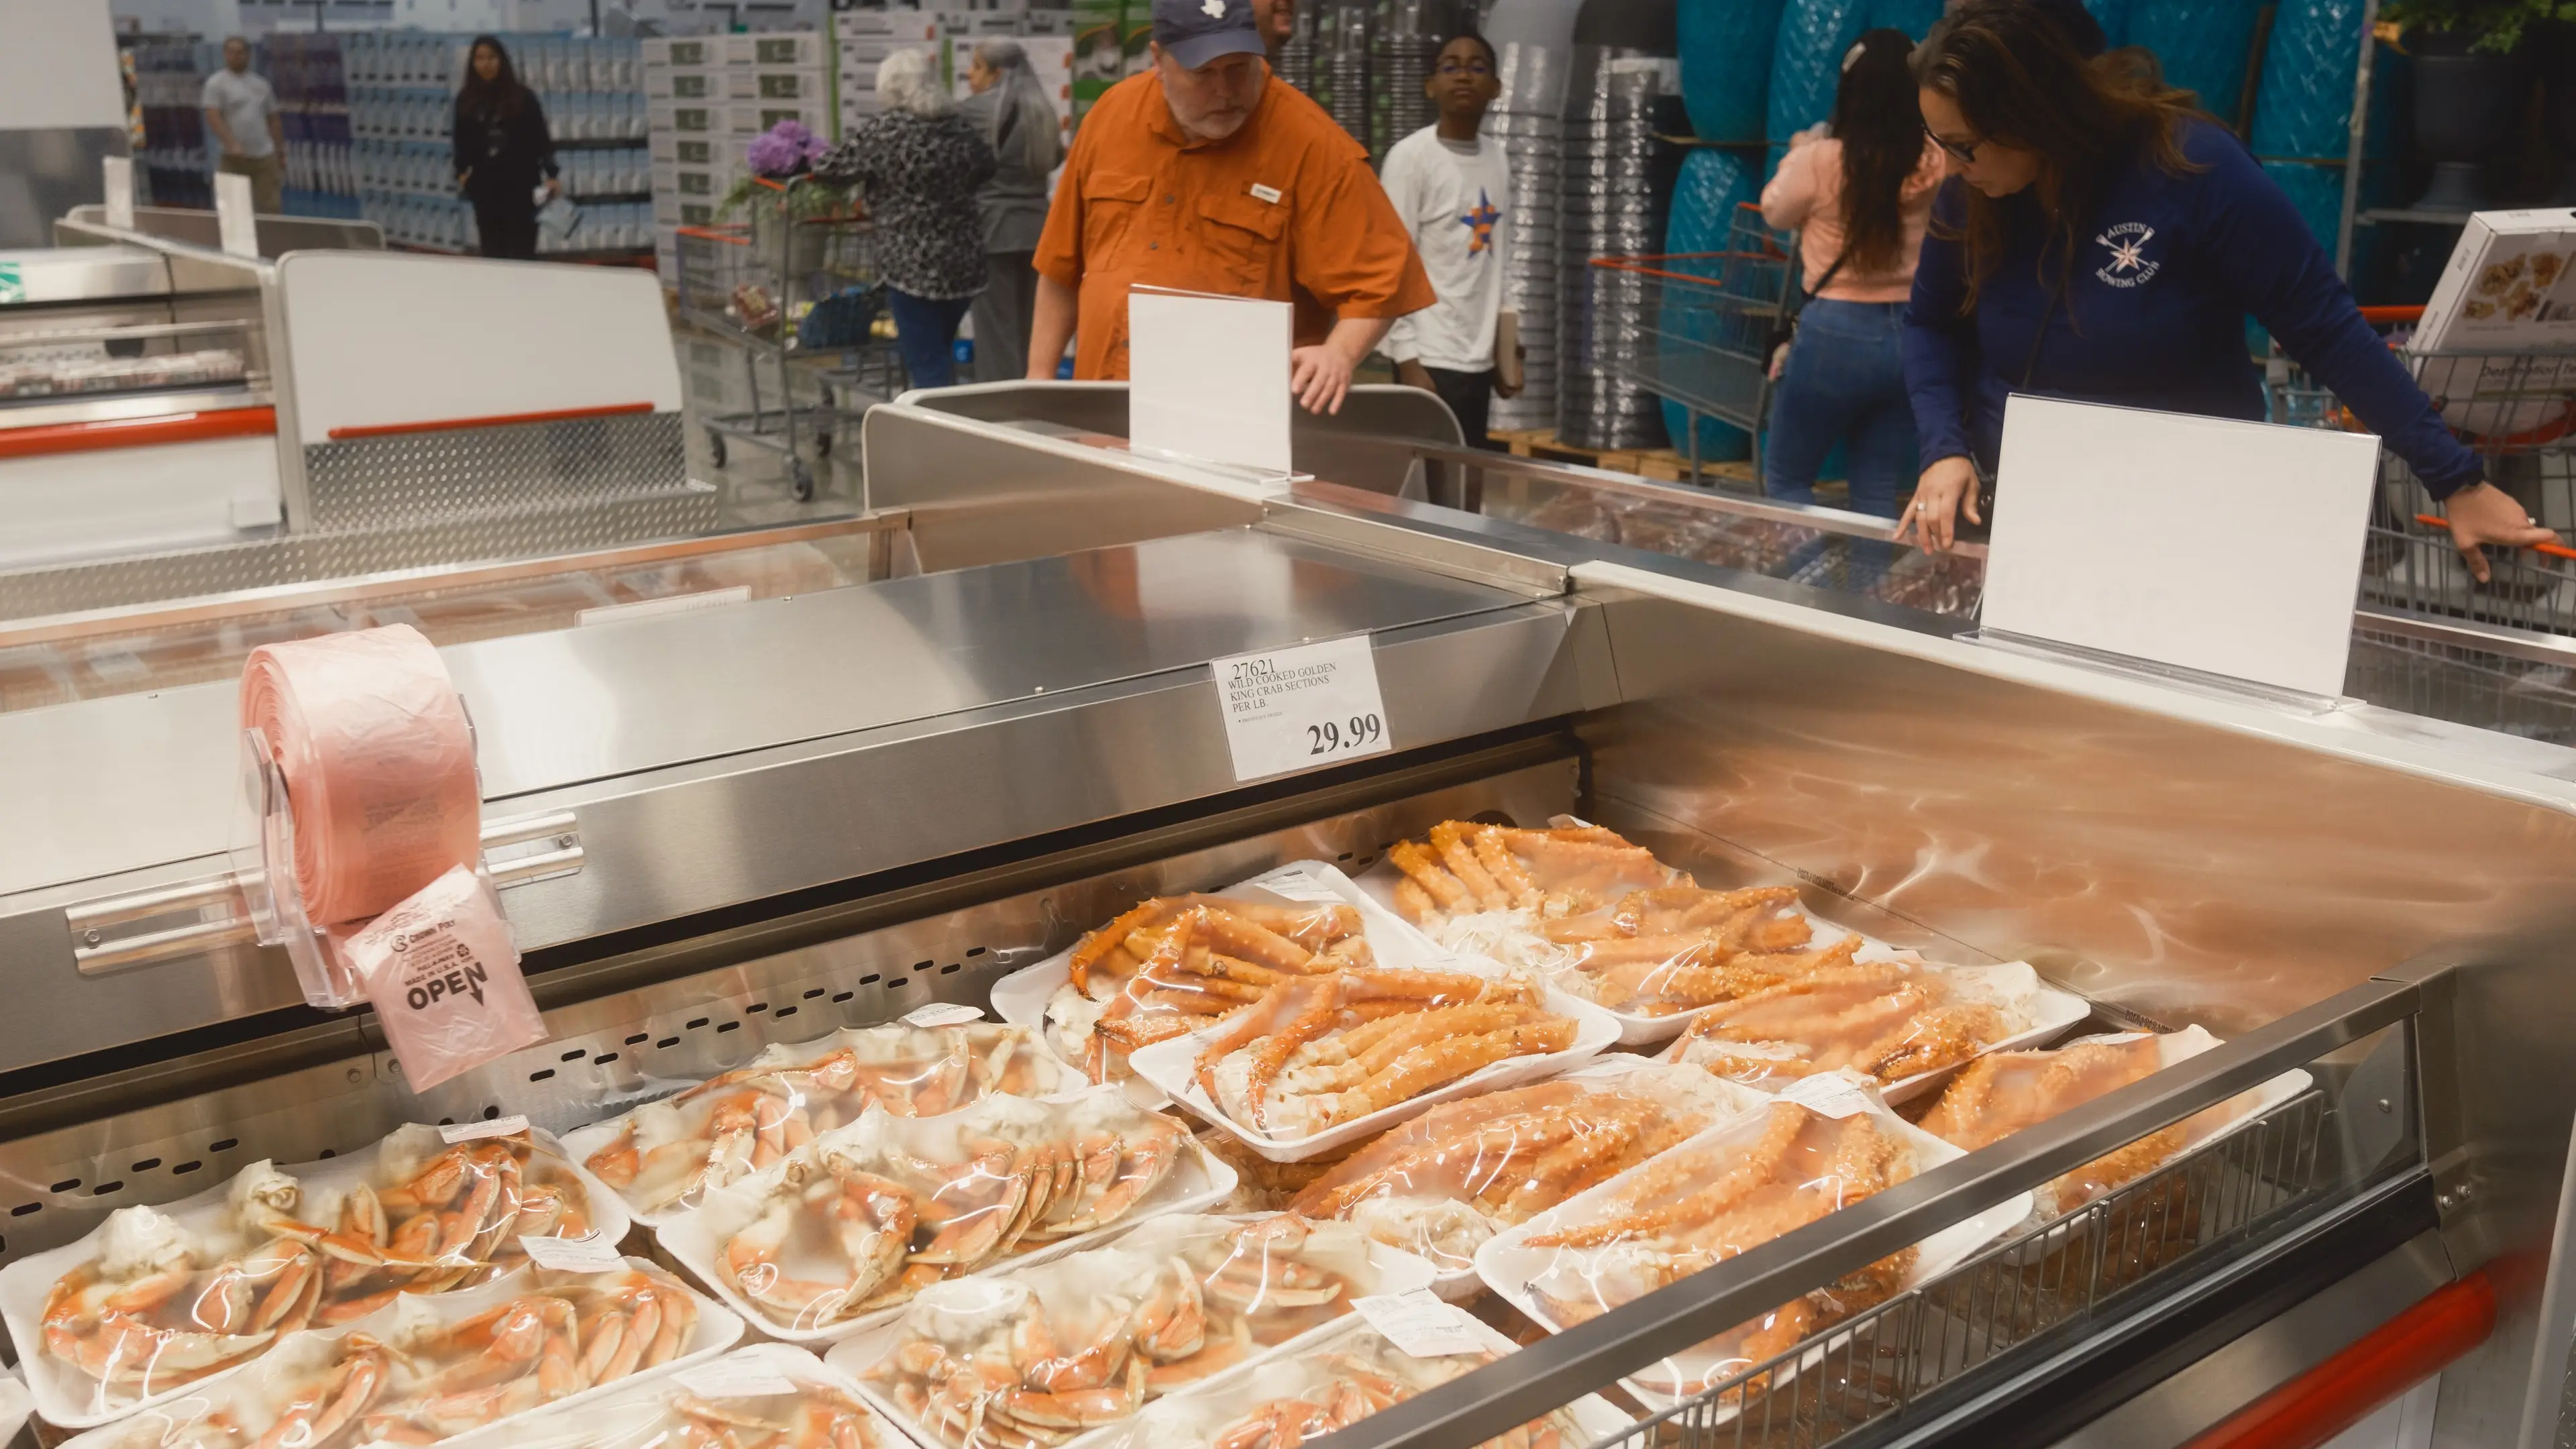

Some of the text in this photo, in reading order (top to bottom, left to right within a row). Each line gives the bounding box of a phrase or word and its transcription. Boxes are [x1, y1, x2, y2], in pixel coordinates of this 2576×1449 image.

[2107, 222, 2147, 239] AUSTIN
[2136, 260, 2160, 284] CLUB
[1228, 662, 1337, 690] WILD COOKED GOLDEN
[1232, 659, 1276, 680] 27621
[1230, 676, 1330, 702] KING CRAB SECTIONS
[1232, 698, 1269, 713] PER LB.
[1307, 713, 1381, 755] 29.99
[408, 962, 488, 1010] OPEN
[2142, 1016, 2157, 1026] LOAD
